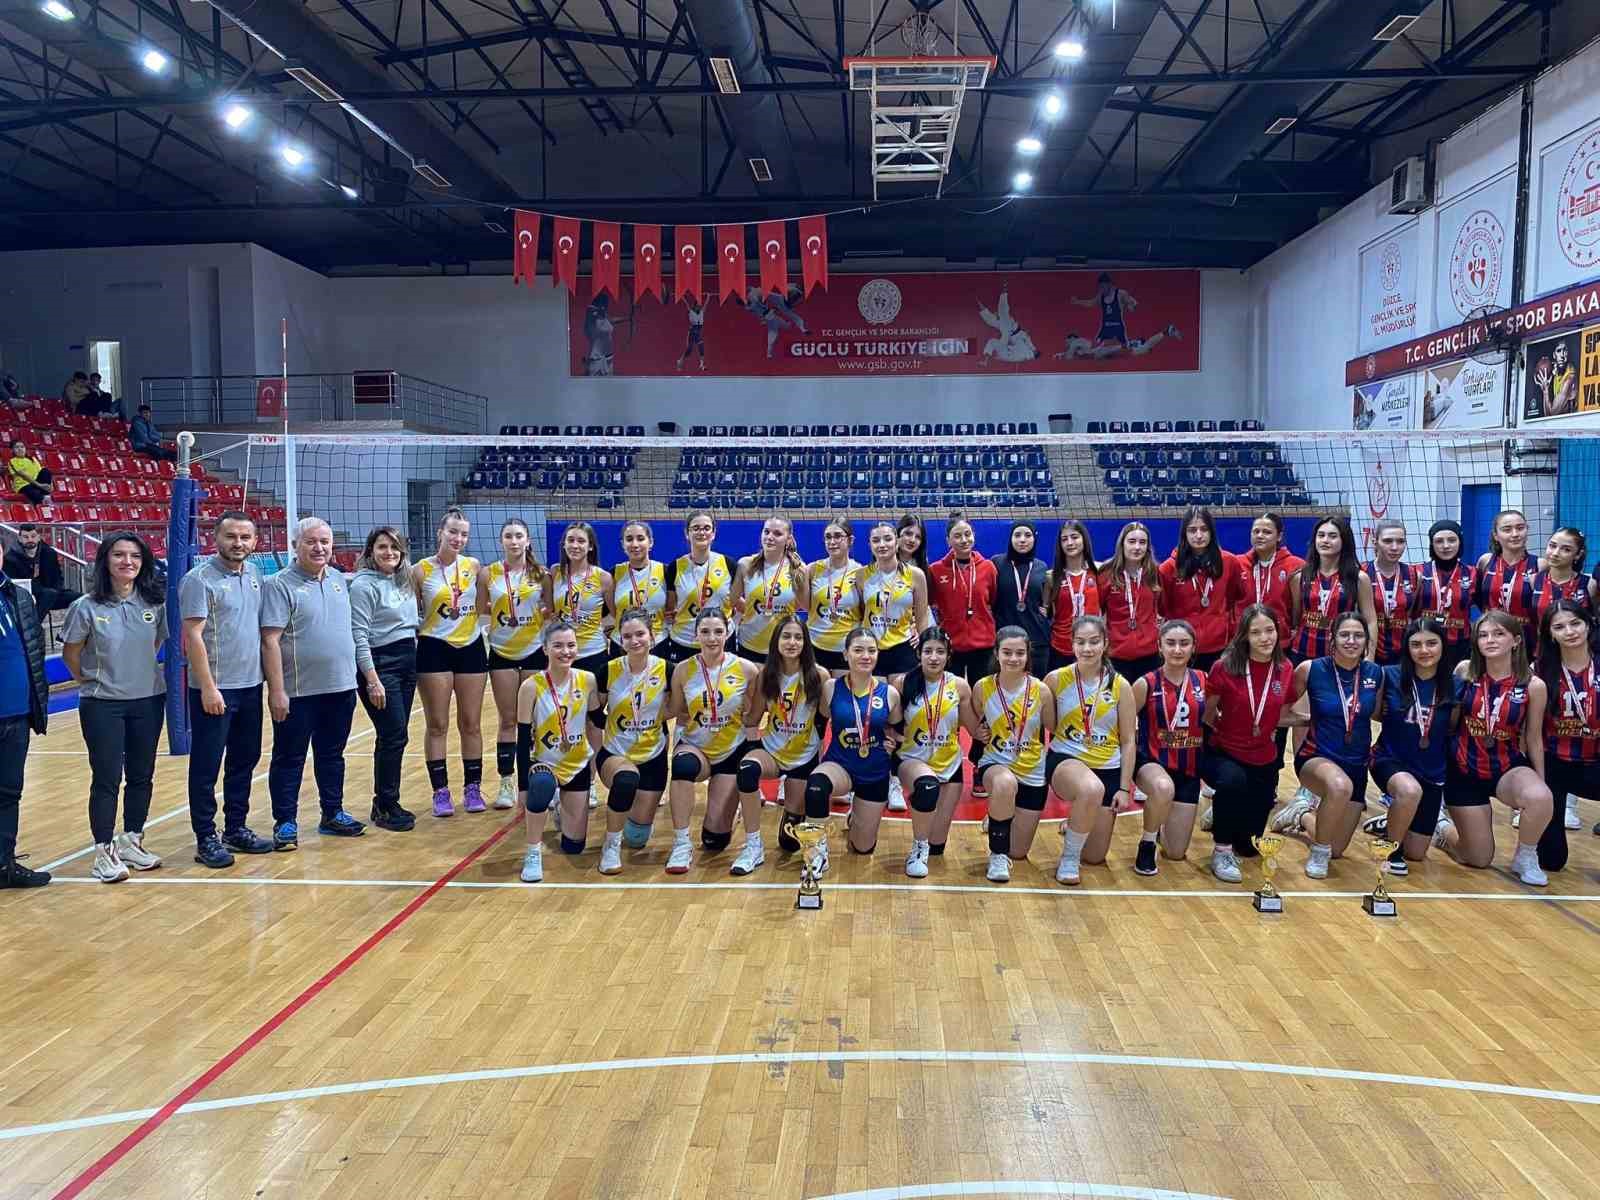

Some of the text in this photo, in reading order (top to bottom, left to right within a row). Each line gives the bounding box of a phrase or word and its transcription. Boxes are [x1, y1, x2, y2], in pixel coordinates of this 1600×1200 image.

[880, 327, 899, 336] SPOR
[1405, 345, 1424, 364] T.C.
[1427, 325, 1481, 358] GENÇLİK
[1505, 306, 1546, 336] SPOR
[1551, 290, 1600, 323] BAKA
[790, 339, 970, 358] GÜÇLÜ TÜRKİYE İÇİN
[838, 358, 922, 371] www.gsb.gov.tr
[782, 692, 793, 712] 5
